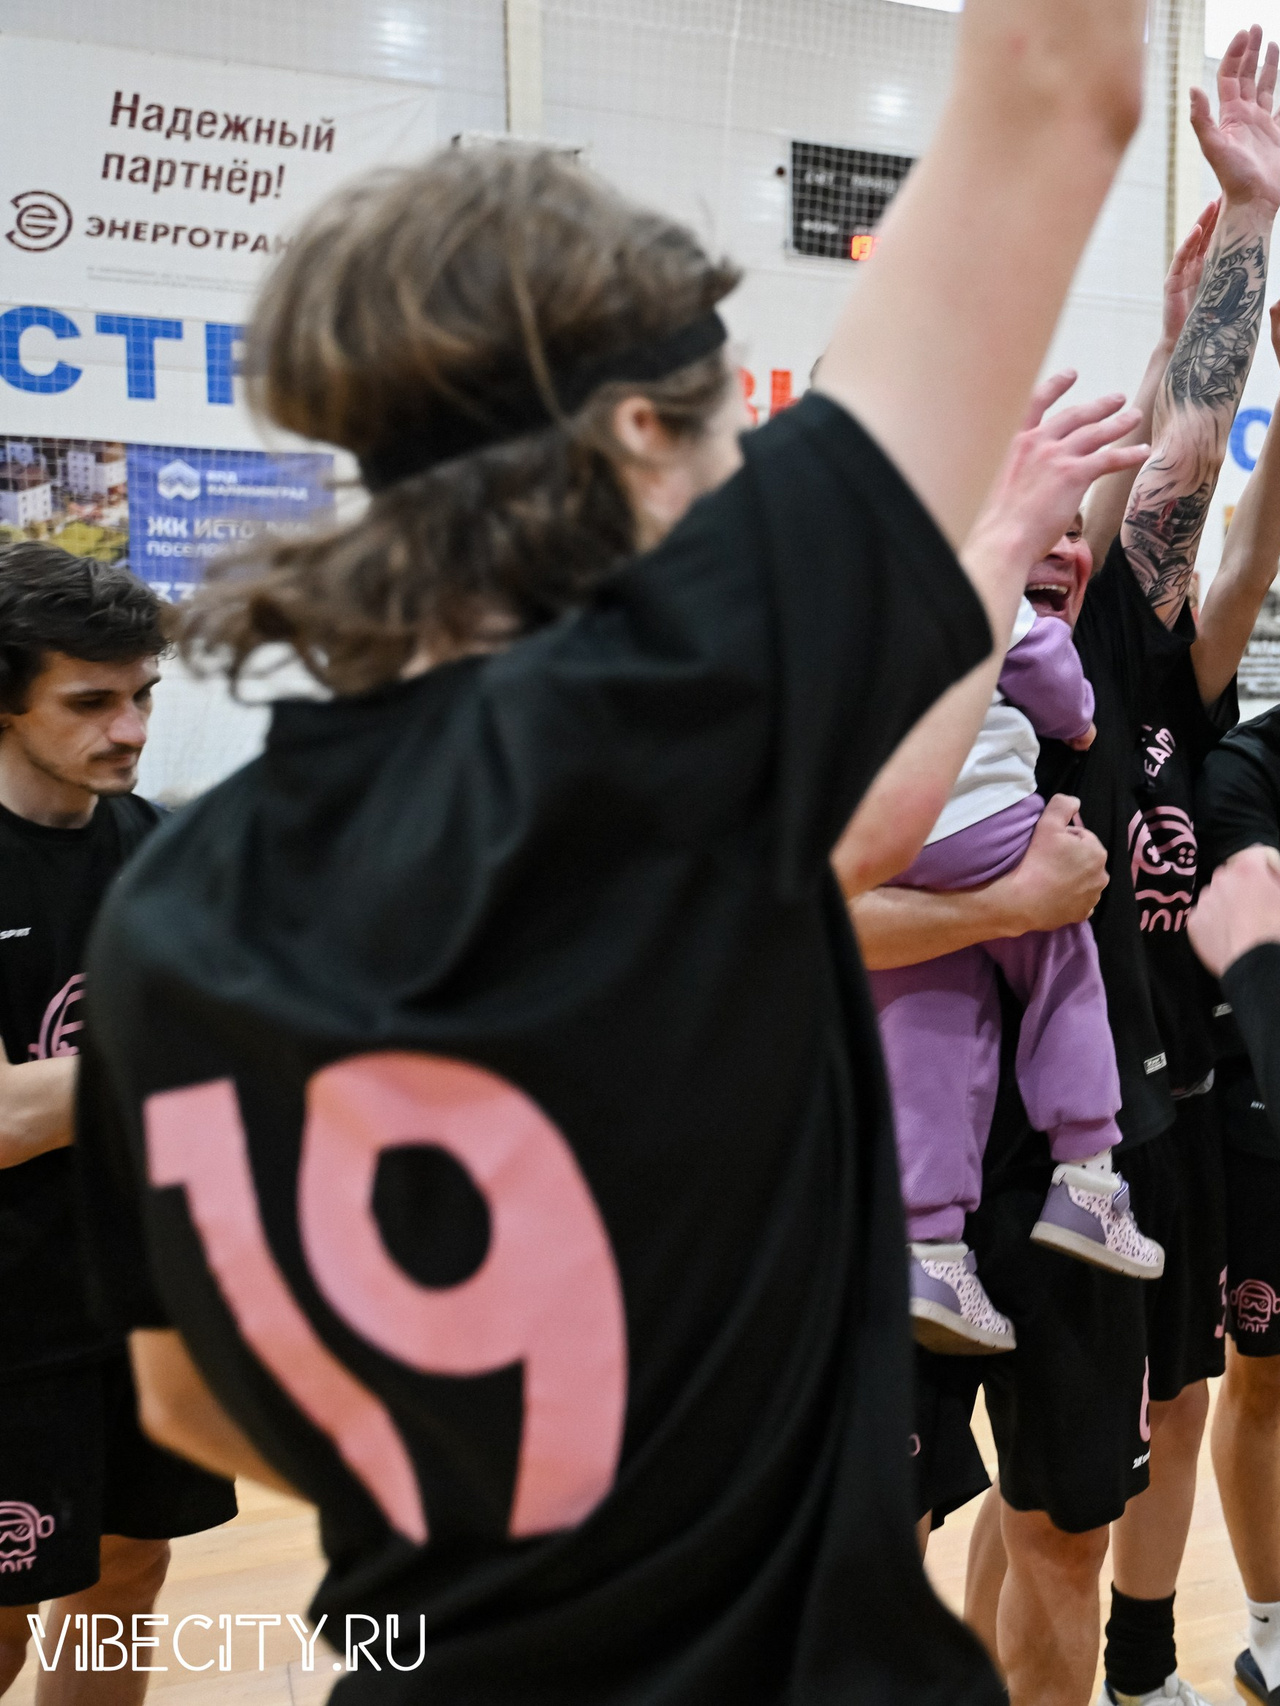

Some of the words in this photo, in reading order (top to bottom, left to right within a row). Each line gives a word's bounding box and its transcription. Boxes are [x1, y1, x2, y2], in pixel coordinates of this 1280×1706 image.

[110, 90, 337, 152] Надежный
[101, 152, 286, 204] партнёр!
[147, 515, 189, 539] ЖК
[144, 1050, 629, 1547] 19
[0, 1555, 37, 1574] NIT
